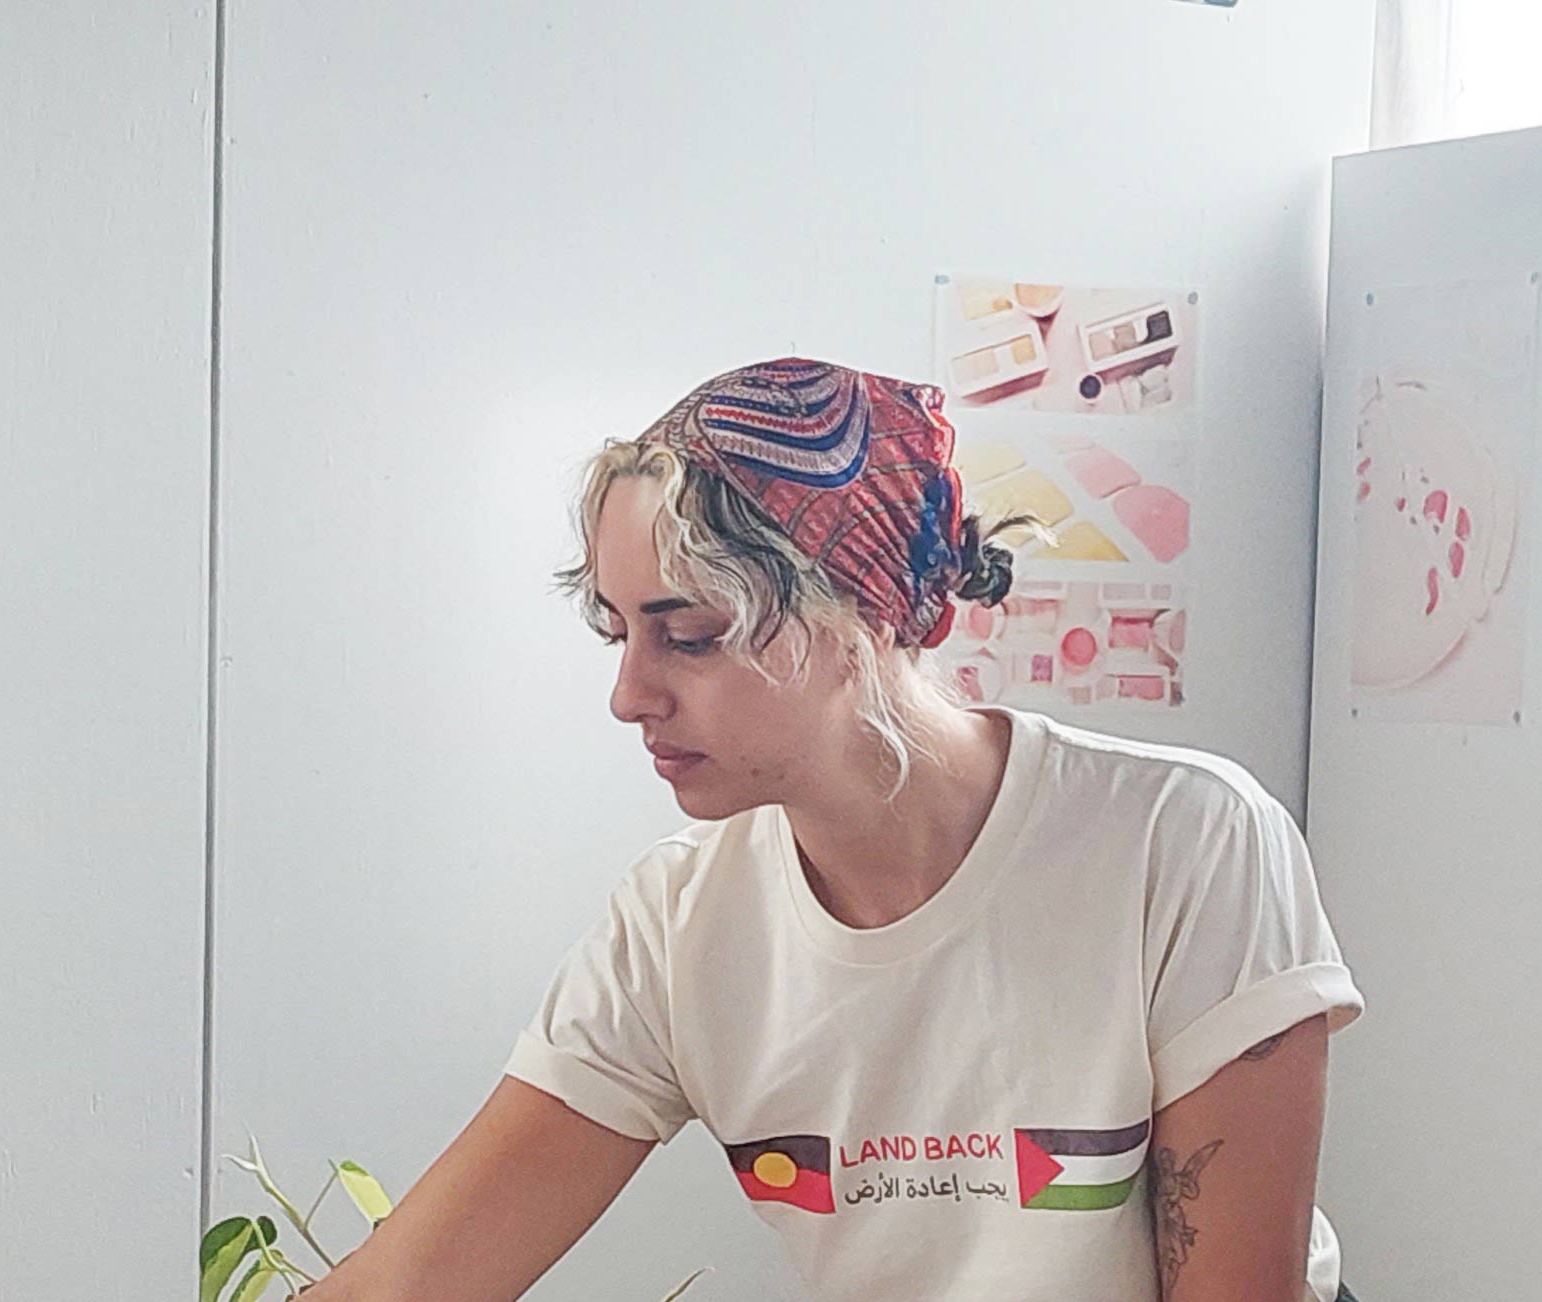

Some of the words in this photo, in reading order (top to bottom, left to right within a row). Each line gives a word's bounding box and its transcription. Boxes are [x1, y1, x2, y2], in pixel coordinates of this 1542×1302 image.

[839, 1135, 917, 1168] LAND
[924, 1133, 1004, 1161] BACK
[844, 1171, 900, 1205] الأرض
[905, 1172, 961, 1202] إعادة
[966, 1180, 1009, 1202] يجب
